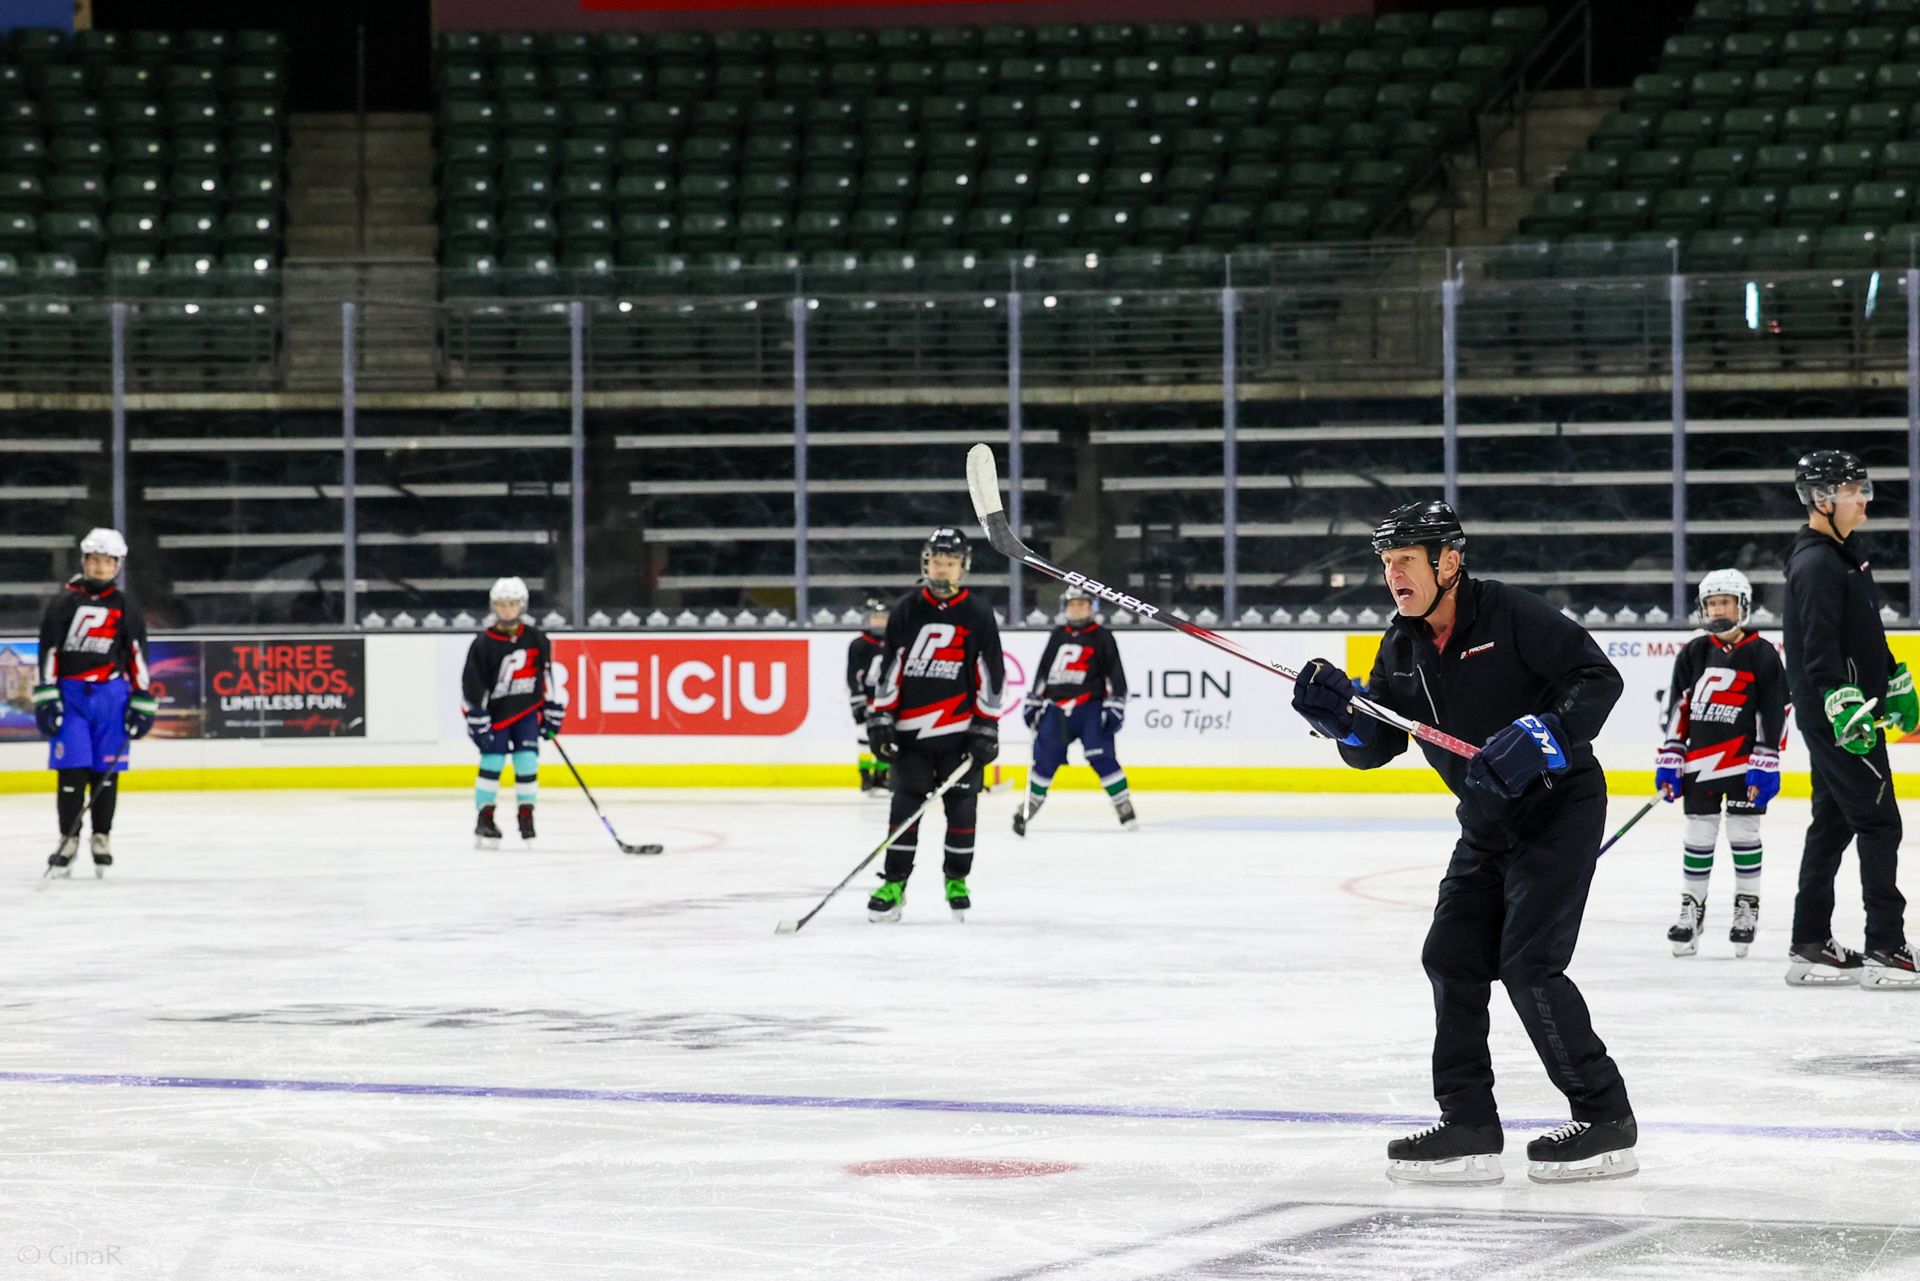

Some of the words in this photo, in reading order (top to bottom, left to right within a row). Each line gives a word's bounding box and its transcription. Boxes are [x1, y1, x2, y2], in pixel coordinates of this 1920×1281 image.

[233, 645, 334, 670] THREE
[1608, 642, 1641, 657] ESC
[212, 669, 355, 697] CASINOS,
[1131, 670, 1231, 698] ION
[220, 694, 305, 712] LIMITLESS
[306, 694, 347, 711] FUN.
[1706, 702, 1743, 718] EDGE
[1144, 708, 1174, 730] Go
[1182, 708, 1232, 734] Tips!
